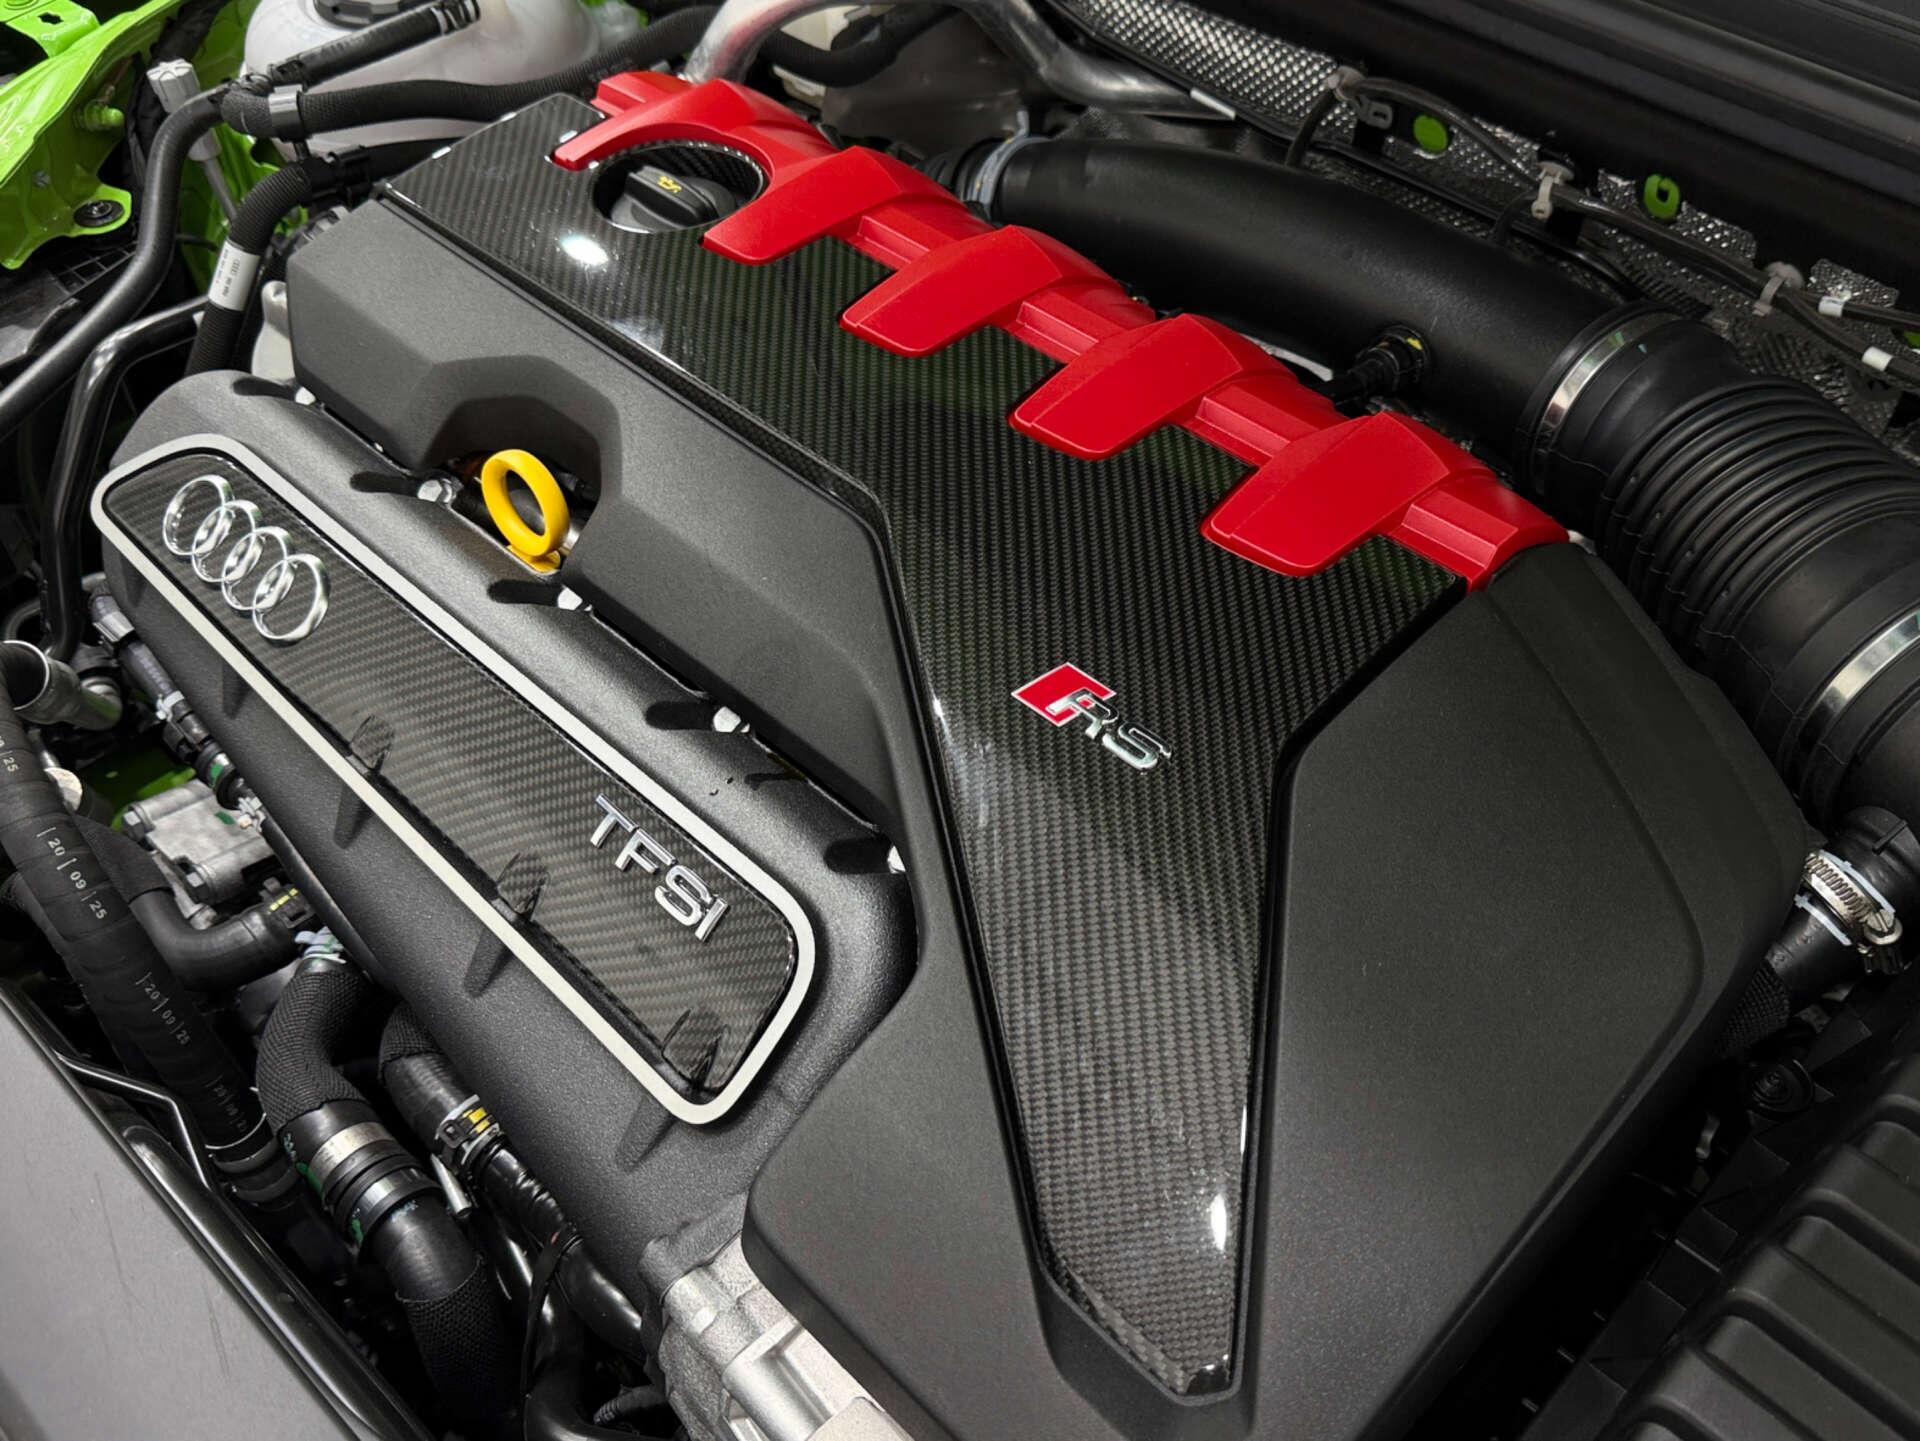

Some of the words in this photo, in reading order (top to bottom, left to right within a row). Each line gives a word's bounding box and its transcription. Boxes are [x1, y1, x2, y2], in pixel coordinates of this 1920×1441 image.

[3, 756, 20, 773] 25
[1044, 687, 1173, 770] RS
[48, 837, 66, 857] 20
[70, 870, 87, 890] 09
[89, 900, 107, 920] 25
[590, 793, 729, 941] TFSI
[144, 983, 161, 1000] 20
